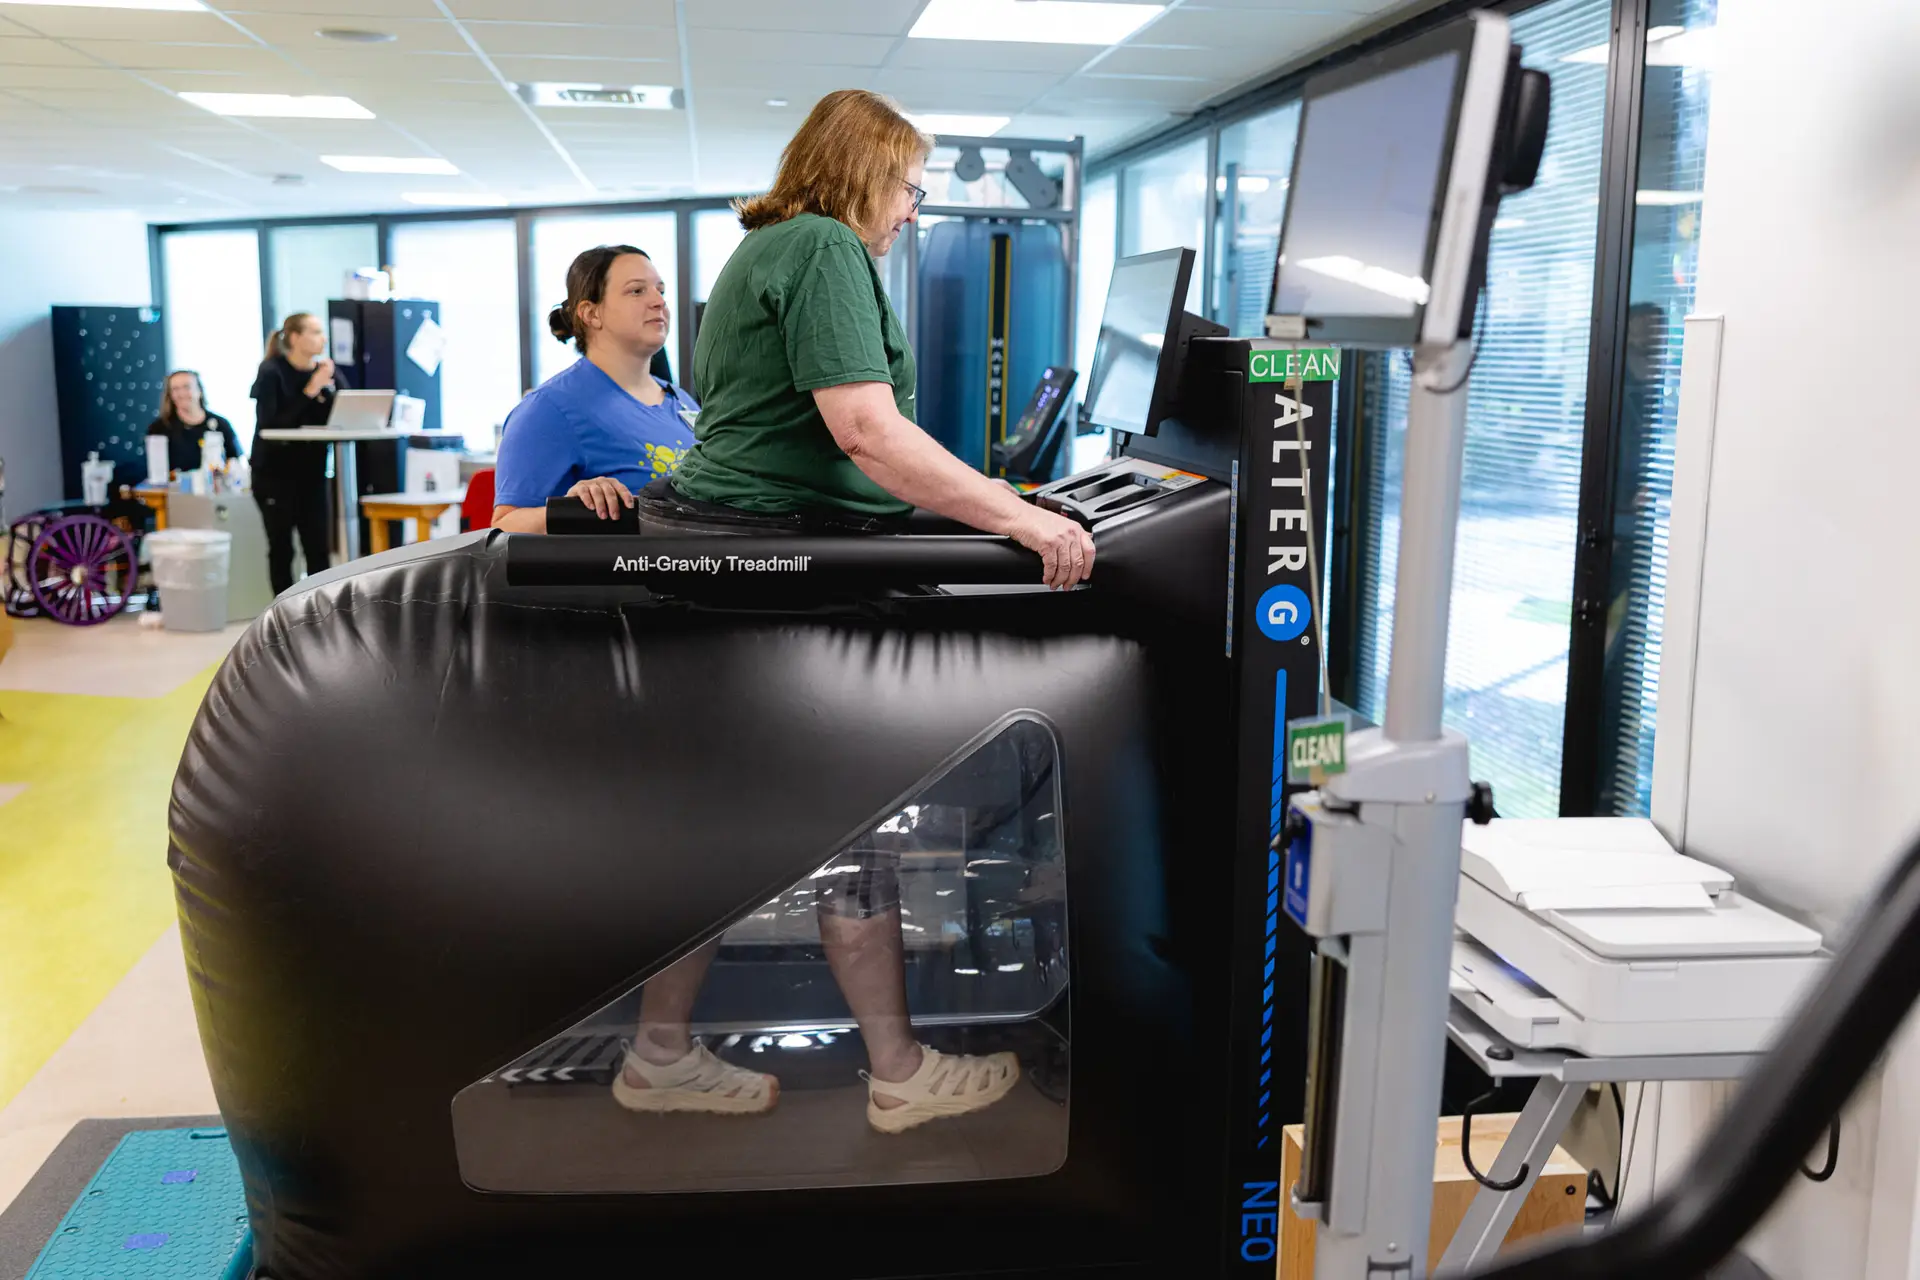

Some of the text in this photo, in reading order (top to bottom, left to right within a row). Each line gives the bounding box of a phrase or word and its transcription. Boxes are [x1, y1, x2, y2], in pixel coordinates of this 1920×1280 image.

[1250, 353, 1340, 378] CLEAN
[1267, 393, 1314, 575] ALTER
[612, 555, 722, 575] Anti-Gravity
[1293, 733, 1342, 768] CLEAN
[1241, 1181, 1278, 1262] NEO
